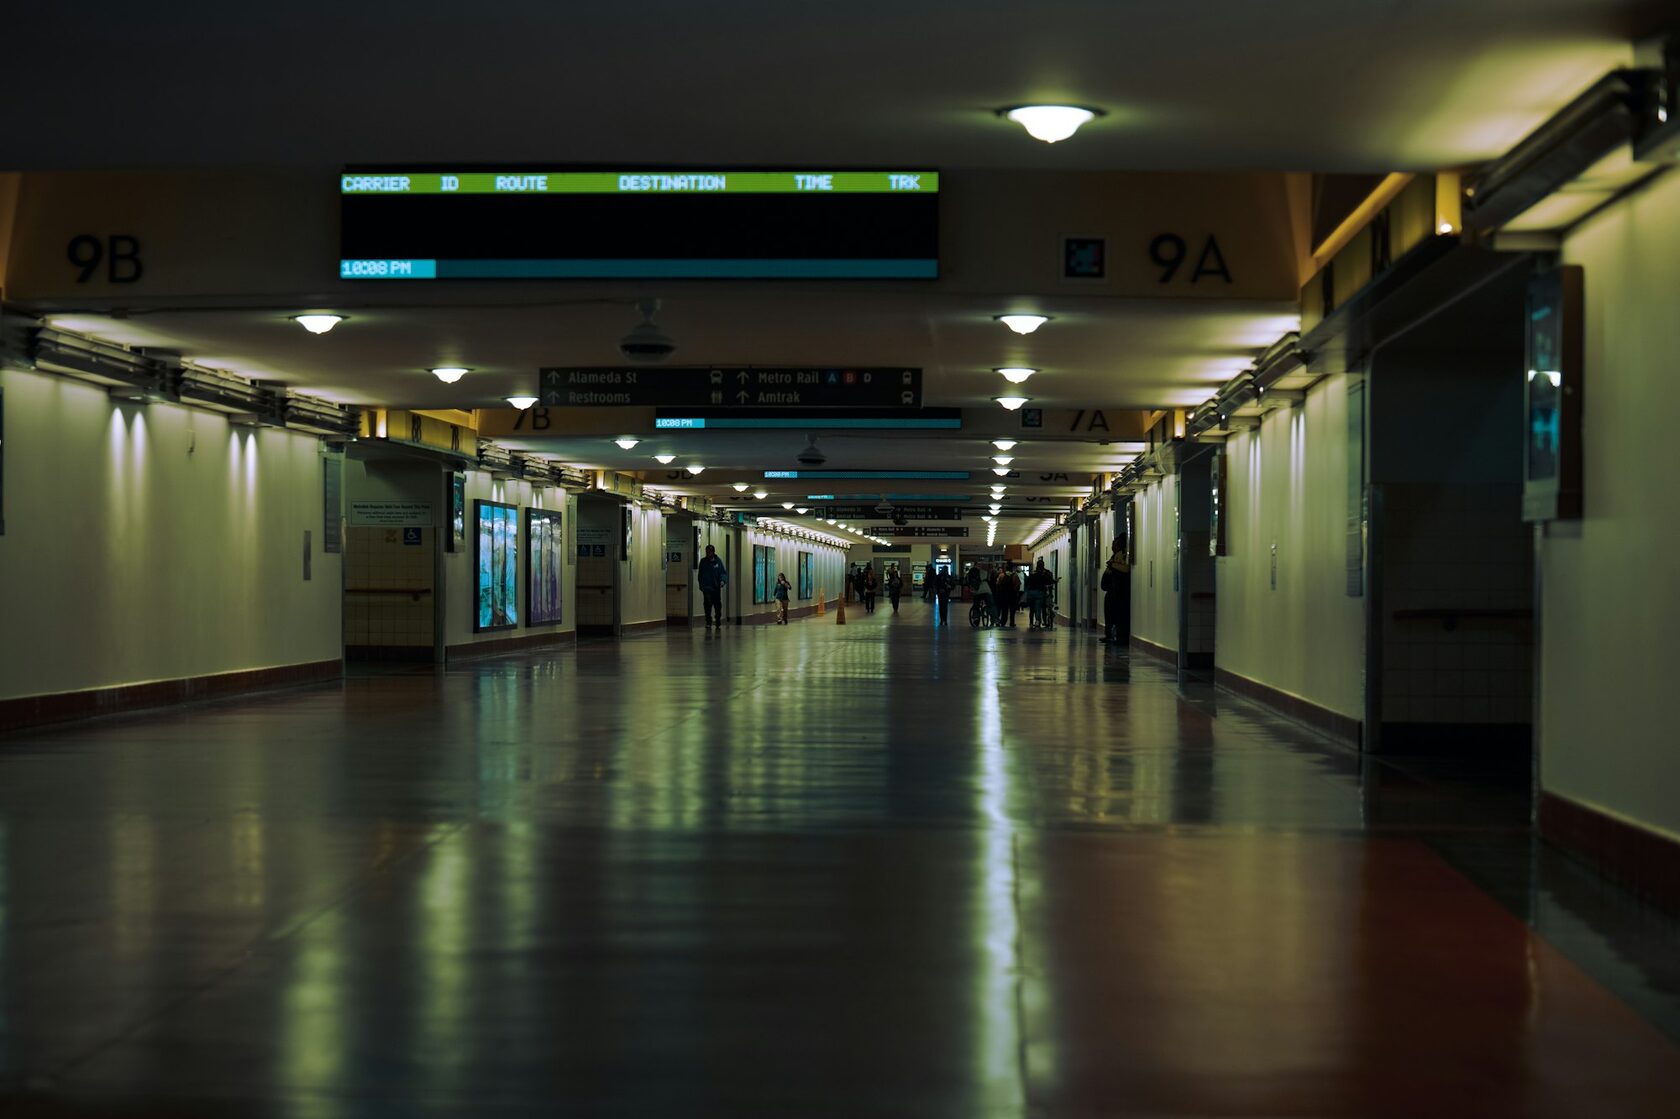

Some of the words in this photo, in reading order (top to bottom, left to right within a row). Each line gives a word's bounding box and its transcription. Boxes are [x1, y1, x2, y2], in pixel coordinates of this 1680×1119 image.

[341, 176, 411, 191] CARRIER
[440, 176, 460, 191] ID
[495, 175, 548, 191] ROUTE
[619, 174, 726, 191] DESTINATION
[794, 174, 833, 191] TIME
[888, 174, 921, 191] TRK
[67, 234, 143, 284] 9B
[1149, 232, 1232, 283] 9A
[390, 260, 412, 275] PM
[568, 371, 621, 383] Alameda
[626, 371, 637, 383] St
[758, 372, 792, 384] Metro
[797, 371, 819, 384] Rail
[828, 372, 837, 383] A
[846, 373, 854, 383] B
[863, 373, 872, 383] D
[568, 391, 631, 403] Restrooms
[757, 391, 801, 403] Amtrak
[681, 418, 693, 427] PM
